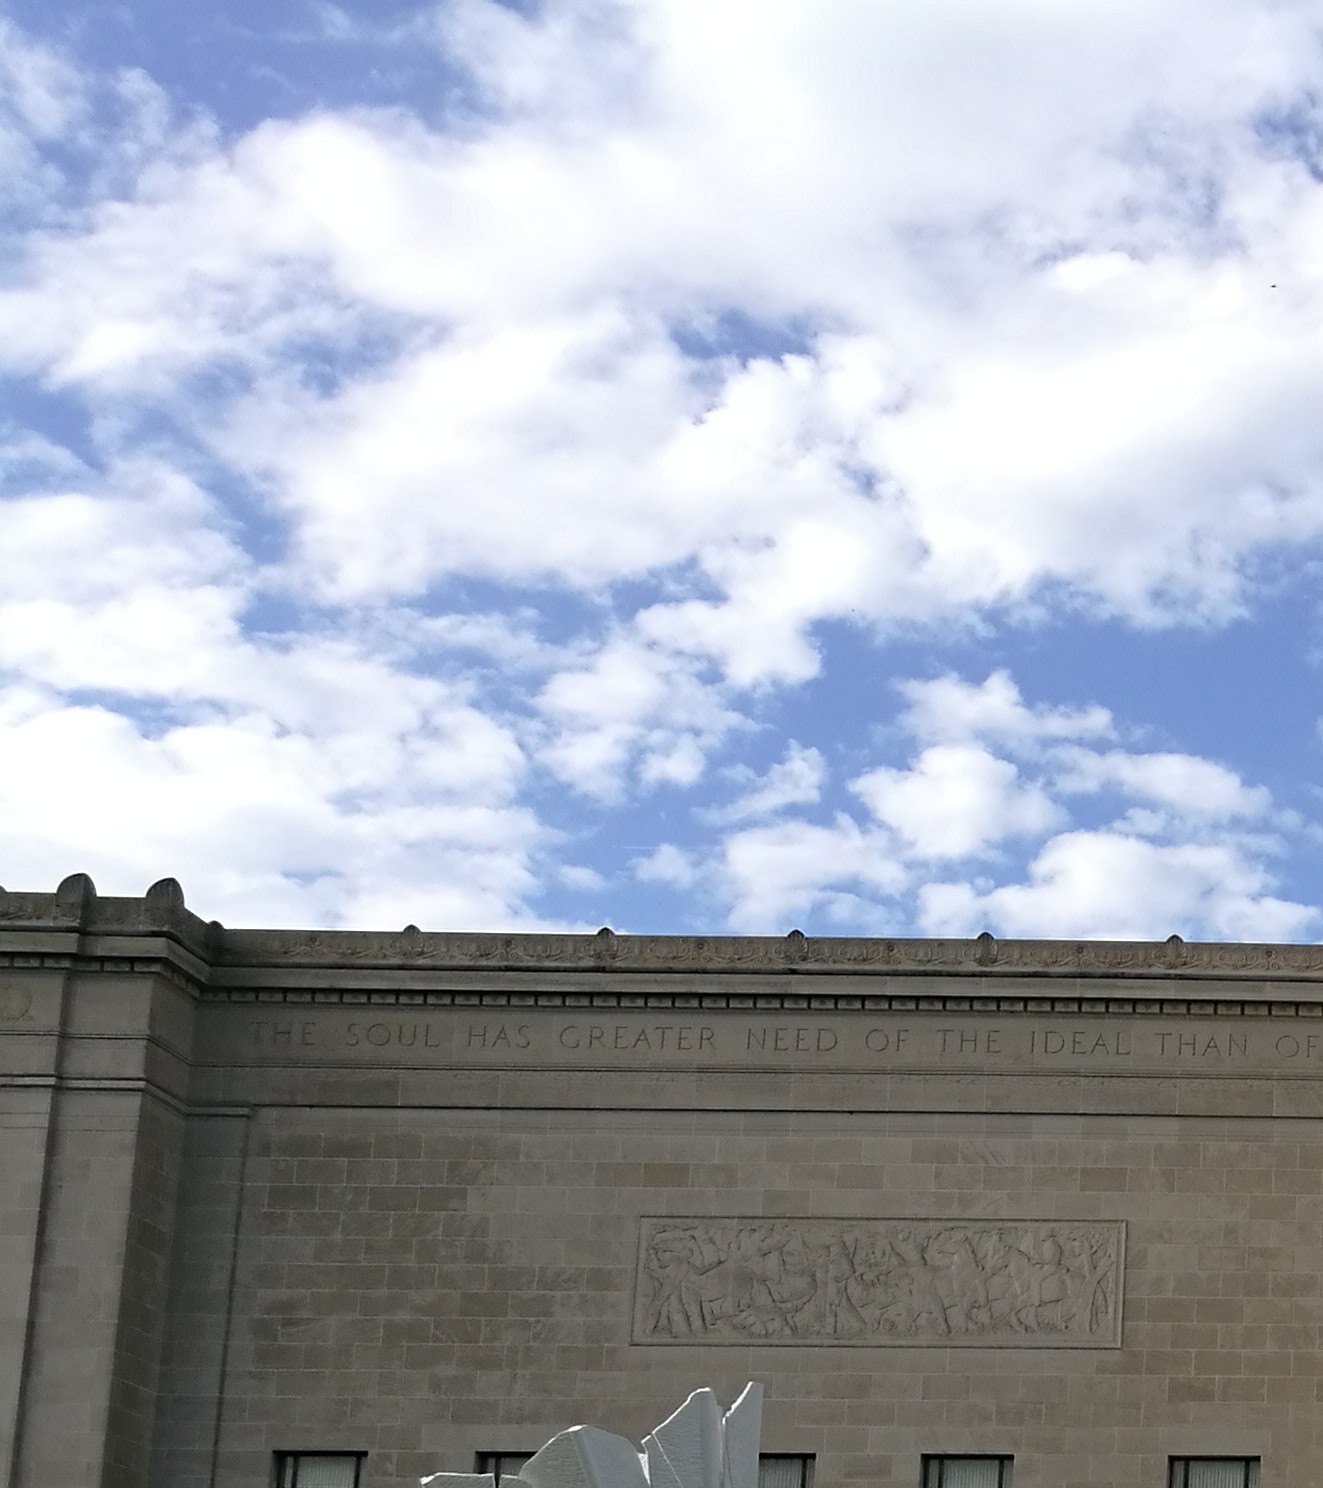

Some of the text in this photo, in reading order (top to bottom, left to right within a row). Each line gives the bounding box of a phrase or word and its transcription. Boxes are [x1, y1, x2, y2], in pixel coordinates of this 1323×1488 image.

[249, 1020, 317, 1047] THE
[345, 1022, 441, 1049] SOUL
[466, 1024, 532, 1050] HAS
[559, 1024, 717, 1053] GREATER
[746, 1026, 839, 1052] NEED
[864, 1027, 910, 1053] OF
[936, 1028, 1002, 1054] THE
[1028, 1030, 1133, 1057] IDEAL
[1153, 1031, 1250, 1059] THAN
[1274, 1034, 1320, 1059] OF
